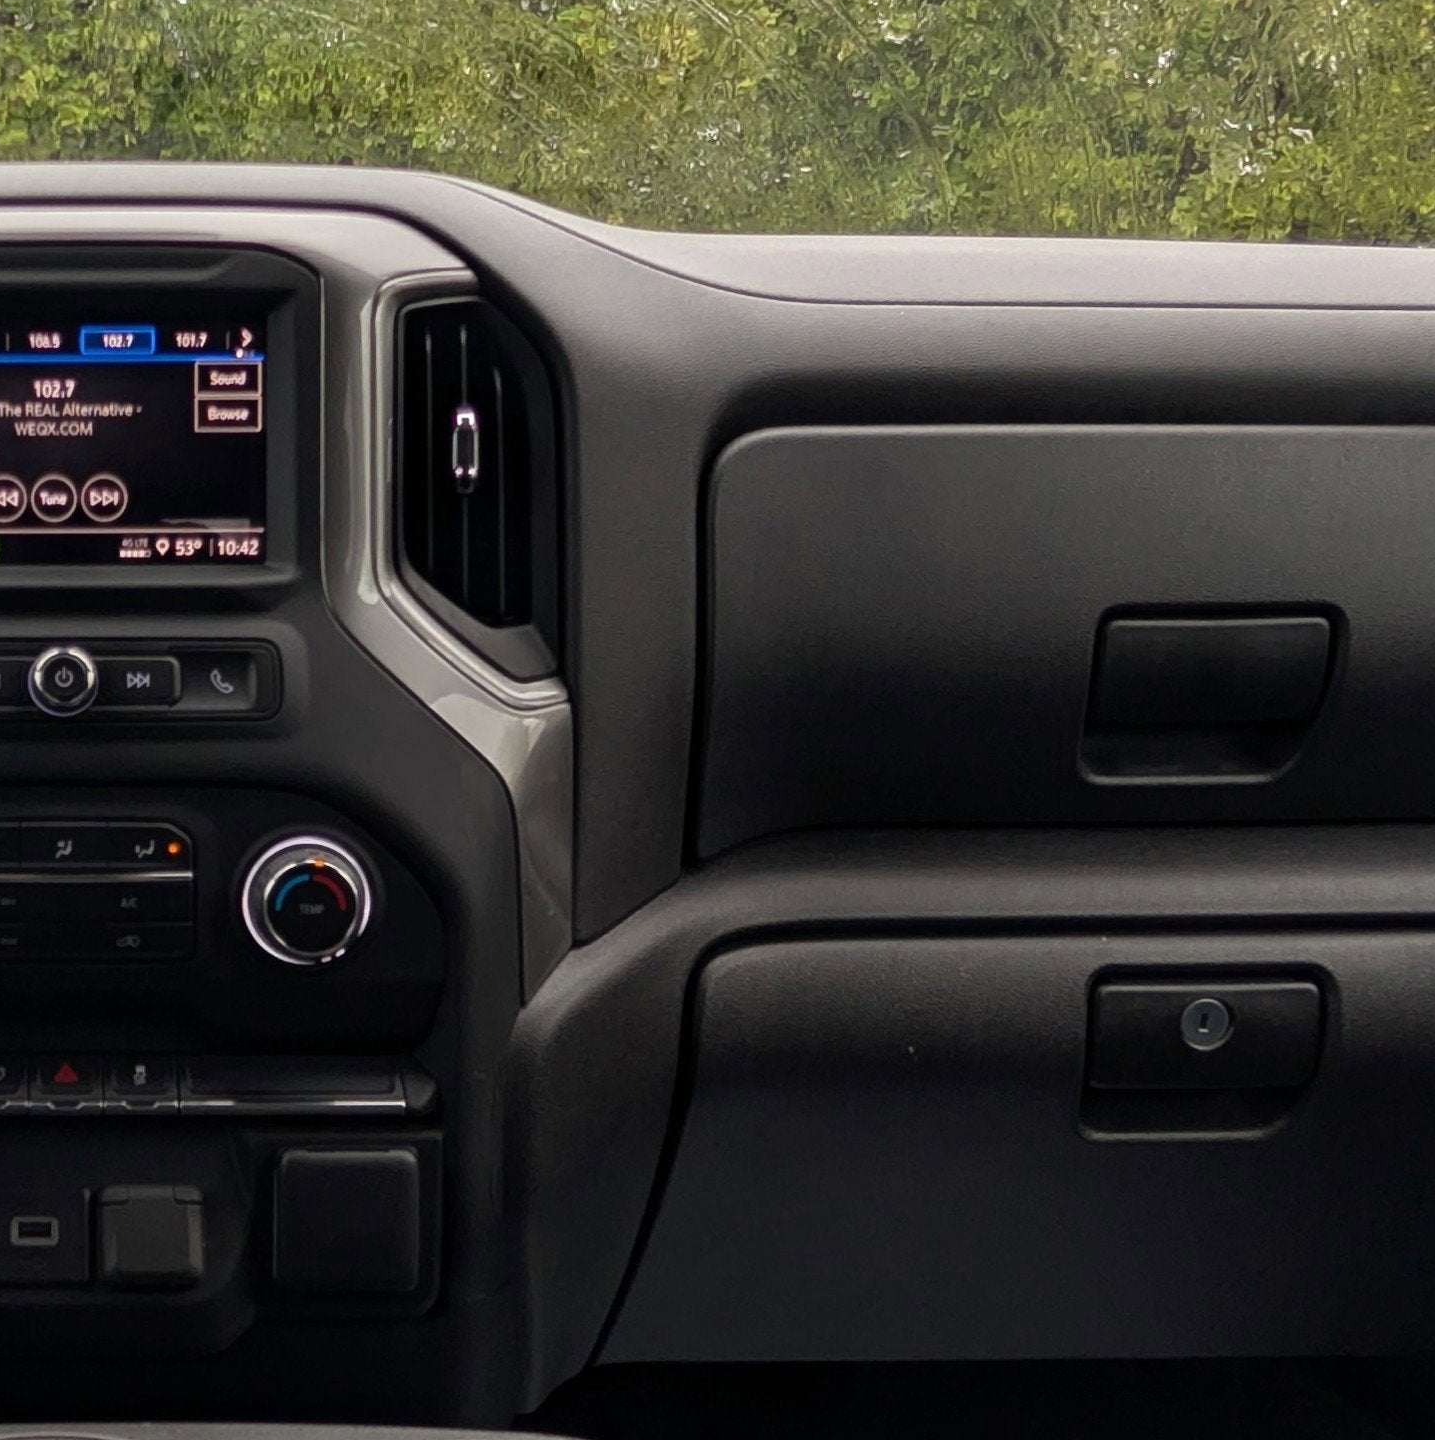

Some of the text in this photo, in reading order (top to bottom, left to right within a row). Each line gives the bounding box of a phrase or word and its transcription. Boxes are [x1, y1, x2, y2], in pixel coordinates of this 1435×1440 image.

[103, 333, 134, 348] 102.7
[176, 332, 207, 348] 101.7
[209, 370, 248, 387] Sound
[33, 379, 76, 399] 102.7
[24, 401, 59, 418] REAL
[61, 400, 135, 418] Alternative
[207, 406, 250, 423] Browse
[13, 420, 94, 439] WEQX.COM
[175, 538, 204, 557] 53°
[217, 538, 260, 557] 10:42
[298, 903, 326, 916] TEMP
